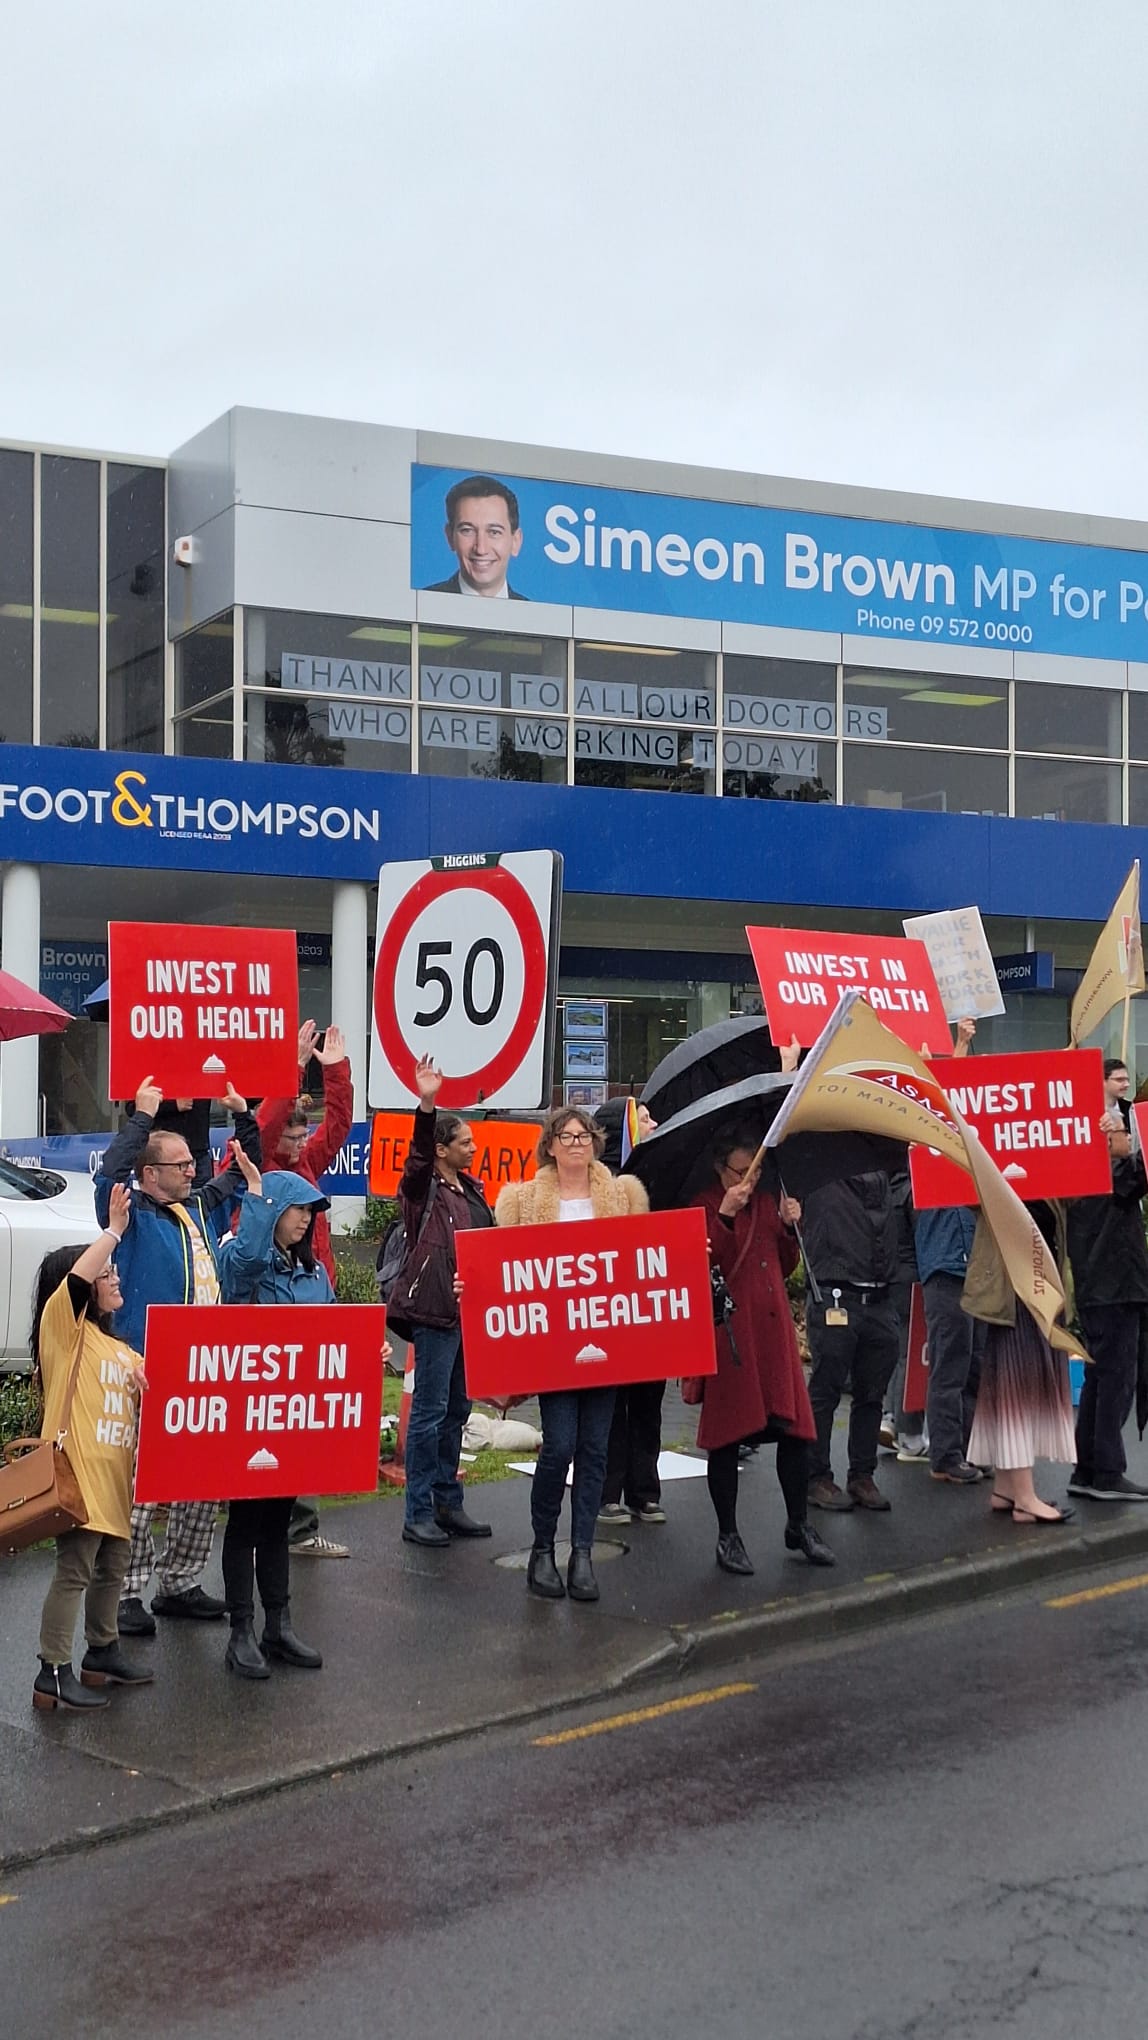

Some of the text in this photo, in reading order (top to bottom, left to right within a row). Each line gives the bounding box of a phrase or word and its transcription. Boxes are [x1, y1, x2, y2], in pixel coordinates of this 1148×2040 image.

[543, 504, 765, 585] Simeon
[785, 532, 956, 606] Brown
[974, 565, 1037, 612] MP
[1049, 574, 1107, 620] for
[857, 608, 1033, 643] Phone 09 572 0000
[288, 657, 883, 735] THANK YOU TO ALL OUR DOCTORS
[330, 707, 815, 772] WHO ARE WORKING TODAY!
[443, 853, 487, 868] HIGGINS
[42, 947, 106, 967] Brown
[784, 951, 908, 982] INVEST IN
[997, 965, 1032, 981] OMPSON
[146, 959, 271, 995] INVEST IN
[413, 937, 504, 1027] 50
[777, 980, 828, 1006] OUR
[130, 1004, 285, 1040] OUR HEALTH
[816, 1084, 848, 1095] TOI
[856, 1090, 909, 1115] MATA
[1048, 1080, 1074, 1110] IN
[993, 1116, 1092, 1151] HEALTH
[502, 1246, 668, 1293] INVEST IN
[485, 1287, 691, 1339] OUR HEALTH
[188, 1344, 347, 1383] INVEST IN
[104, 1390, 123, 1416] IN
[165, 1396, 228, 1434] OUR
[245, 1392, 363, 1431] HEALTH
